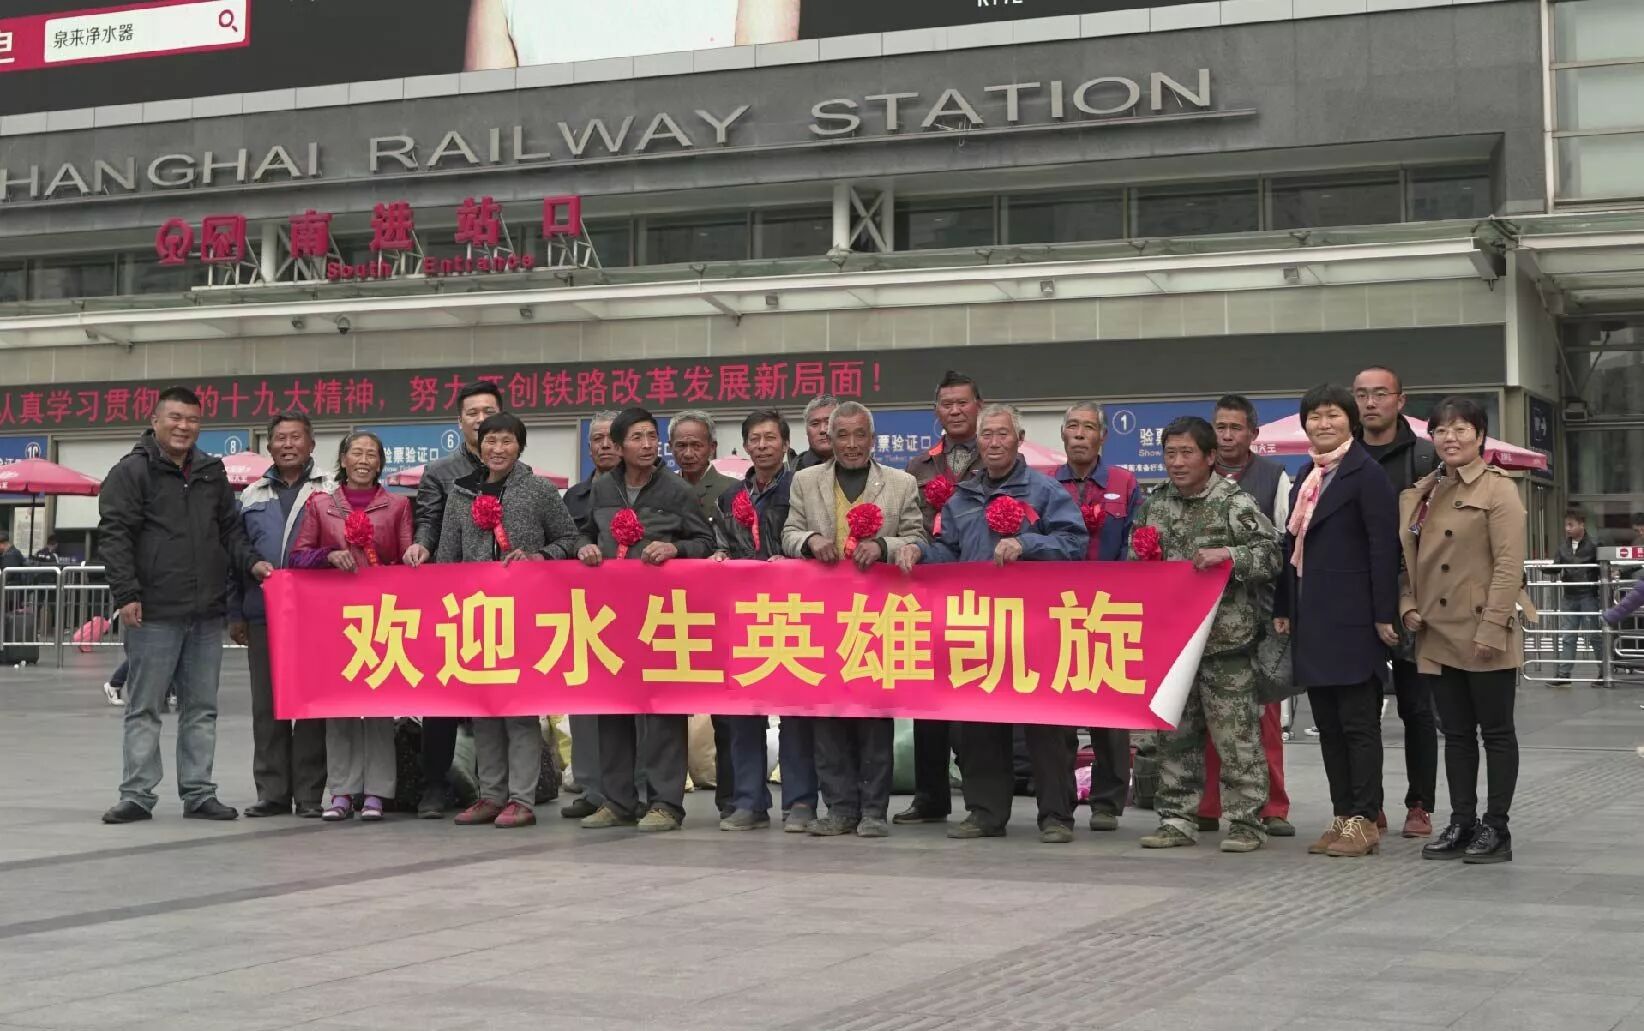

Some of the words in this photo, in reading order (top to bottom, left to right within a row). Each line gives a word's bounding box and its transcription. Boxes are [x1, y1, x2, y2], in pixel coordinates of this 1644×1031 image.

[53, 23, 134, 49] 泉来净水器
[369, 105, 751, 172] RAILWAY
[808, 68, 1211, 136] STATION
[327, 260, 392, 281] South
[422, 252, 535, 276] Entrance
[1120, 414, 1129, 431] 1
[230, 440, 237, 454] 8
[447, 434, 454, 449] 6
[341, 588, 1147, 694] 欢迎水生英雄凯旋
